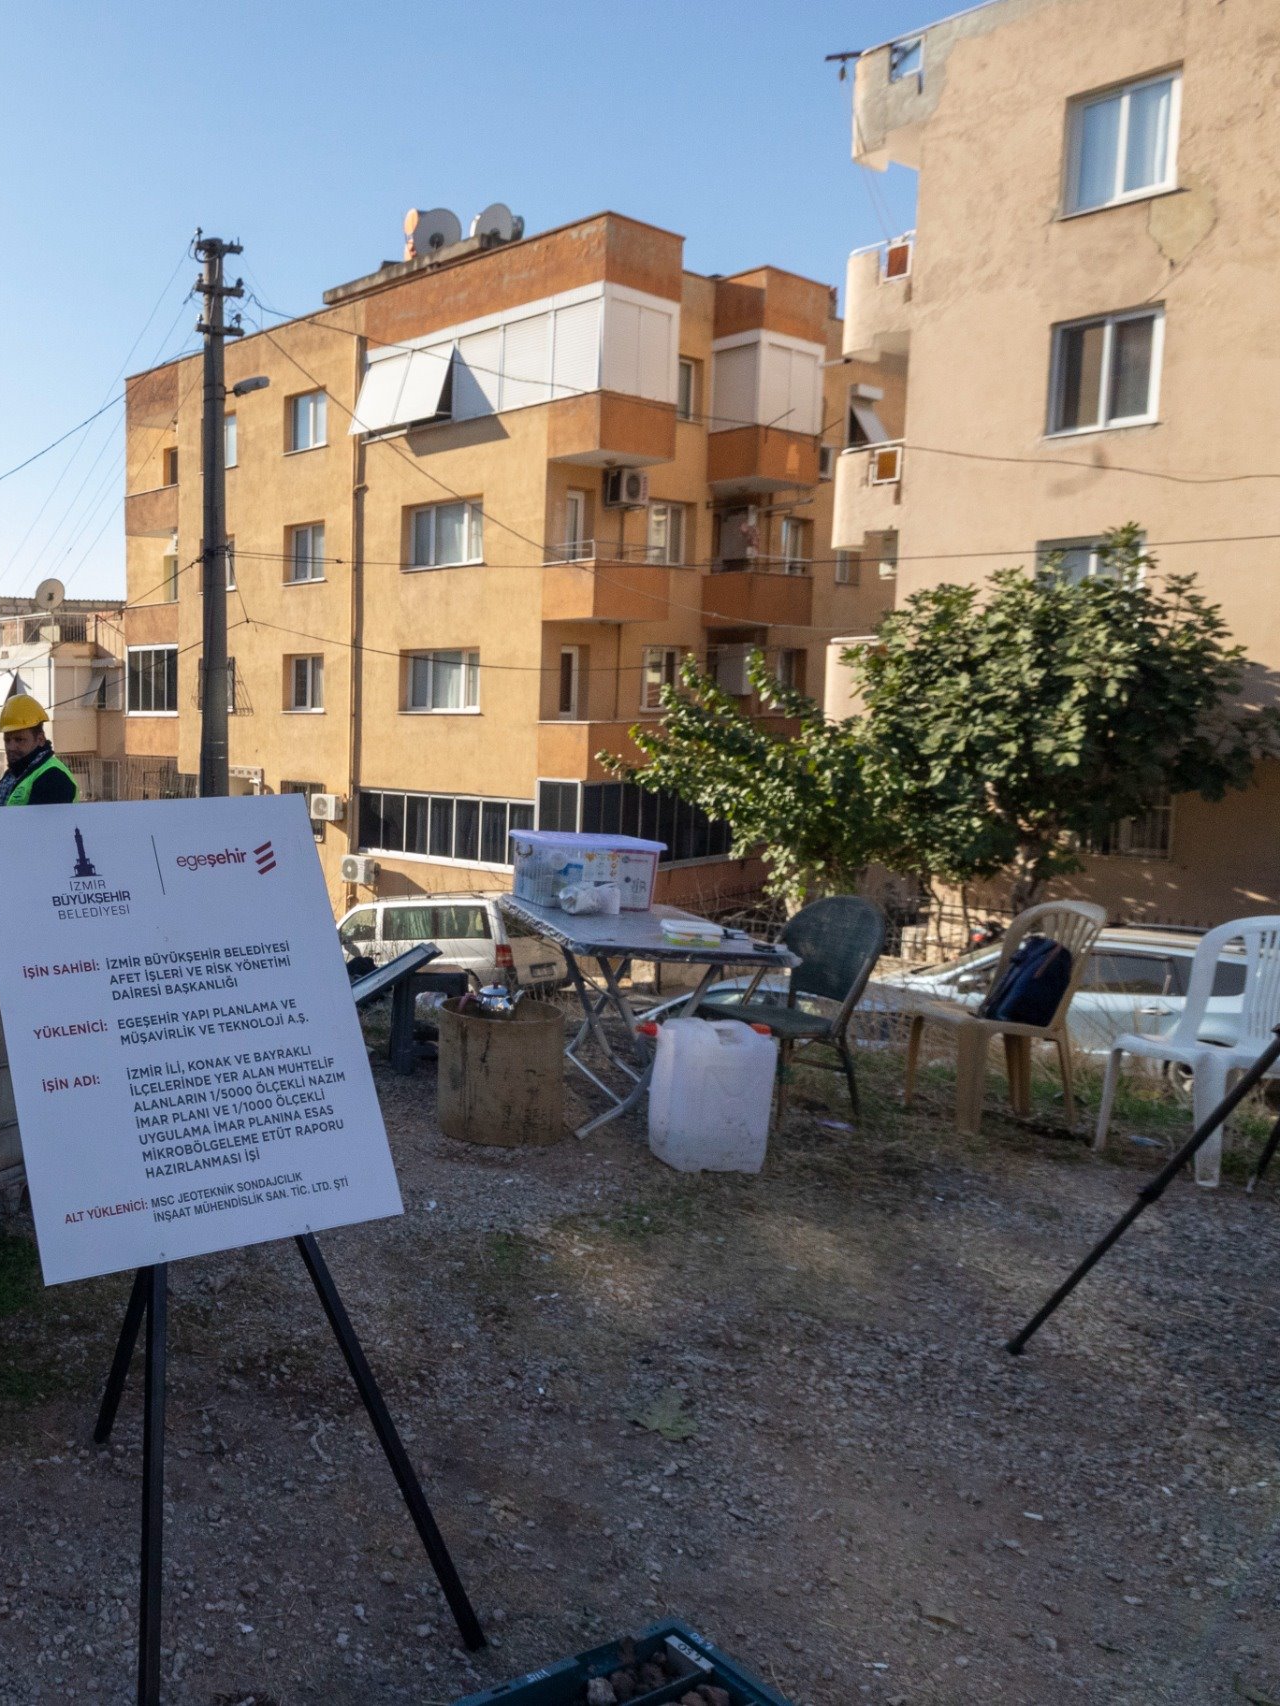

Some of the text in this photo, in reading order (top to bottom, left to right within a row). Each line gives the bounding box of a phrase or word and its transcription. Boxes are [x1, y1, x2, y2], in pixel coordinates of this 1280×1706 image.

[175, 846, 247, 872] egeşehir
[50, 888, 132, 907] BÜYÜKŞEHİR
[68, 878, 106, 891] İZMİR
[56, 903, 130, 920] BELEDİYESİ
[21, 957, 101, 980] İŞİN SAHİBİ:
[104, 938, 290, 970] İZMİR BÜYÜKŞEHİR BELEDİYESİ
[108, 953, 291, 986] AFET İŞLERİ VE RİSK YÖNETİMİ
[110, 974, 238, 1001] DAİRESİ BAŞKANLIĞI
[31, 1017, 108, 1040] YÜKLENİCİ:
[116, 997, 297, 1030] EGEŞEHİR YAPI PLANLAMA VE
[119, 1011, 309, 1046] MÜŞAVİRLİK VE TEKNOLOJİ A.Ş.
[125, 1044, 312, 1080] İZMİR İLİ, KONAK VE BAYRAKLI
[128, 1055, 334, 1097] İLÇELERİNDE YER ALAN MUHTELİF
[40, 1073, 101, 1094] İŞİN ADI:
[132, 1070, 346, 1113] ALANLARIN 1/5000 ÖLÇEKLİ NAZIM
[134, 1087, 326, 1129] İMAR PLANI VE 1/1000 ÖLÇEKLİ
[137, 1103, 334, 1146] UYGULAMA İMAR PLANINA ESAS
[140, 1117, 344, 1163] MİKROBÖLGELEME ETÜT RAPORU
[144, 1145, 261, 1179] HAZIRLANMASI İŞİ
[152, 1174, 349, 1223] İNŞAAT MÜHENDİSLİK SAN. TİC. LTD. ŞTİ
[176, 1182, 236, 1204] JEOTEKNİK
[235, 1170, 303, 1193] SONDAJCILIK
[63, 1196, 149, 1225] ALT YÜKLENİCİ:
